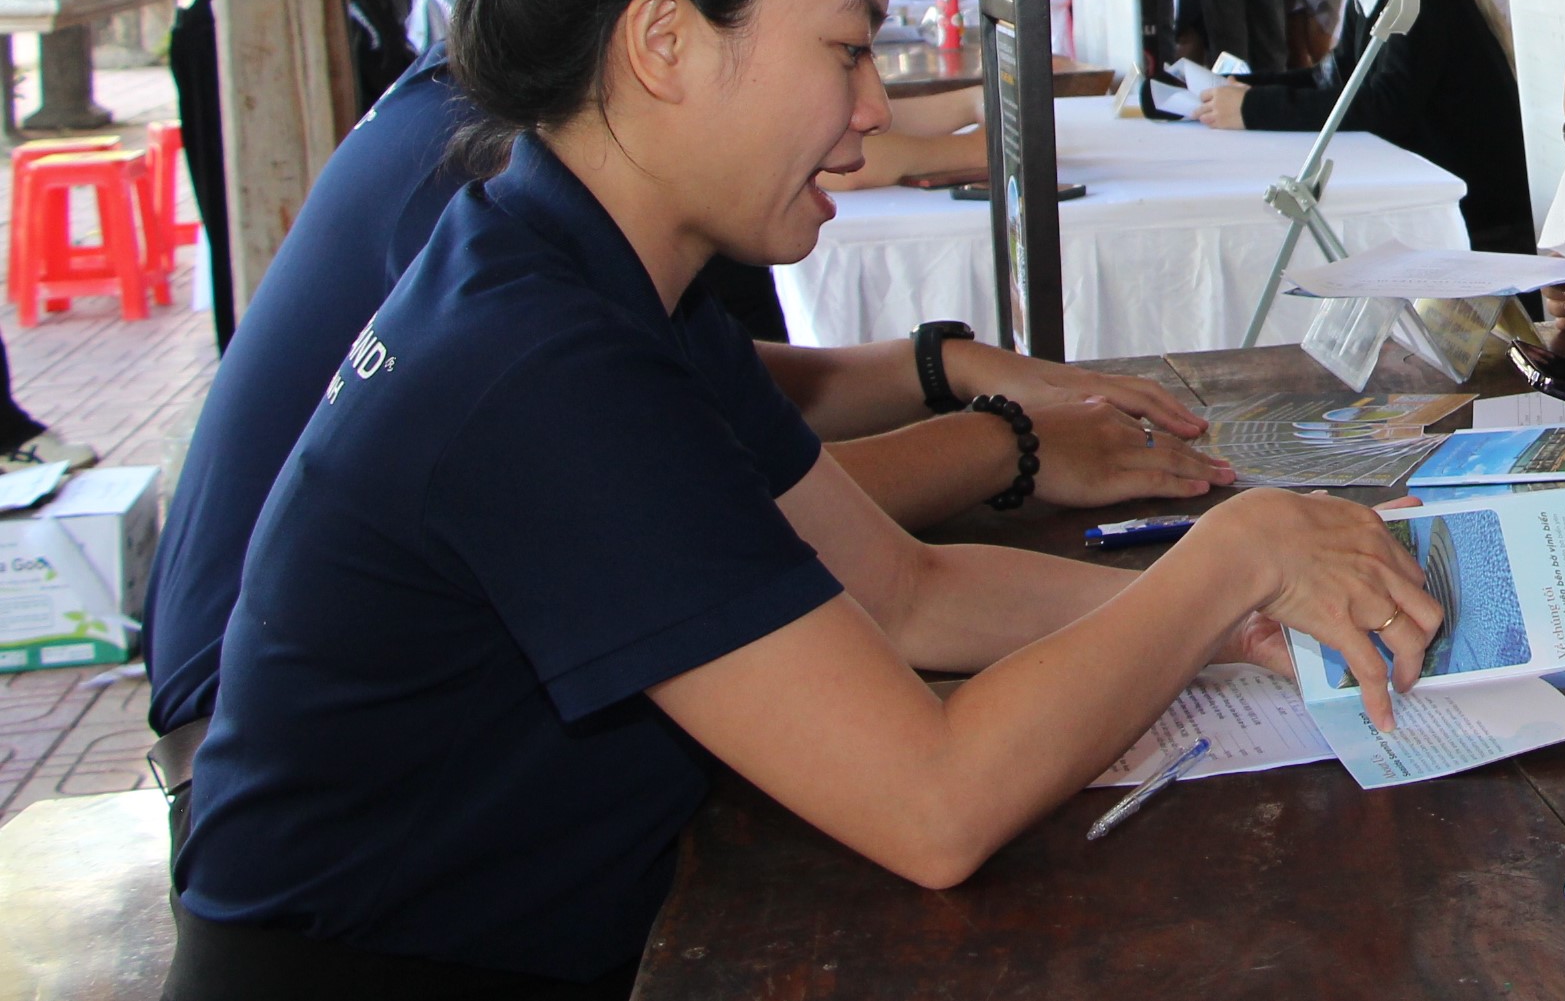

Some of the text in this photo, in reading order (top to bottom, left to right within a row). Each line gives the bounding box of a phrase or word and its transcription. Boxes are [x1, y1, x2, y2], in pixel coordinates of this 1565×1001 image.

[1546, 533, 1556, 553] vịnh
[1546, 586, 1554, 602] tôi
[1550, 604, 1564, 640] chúng
